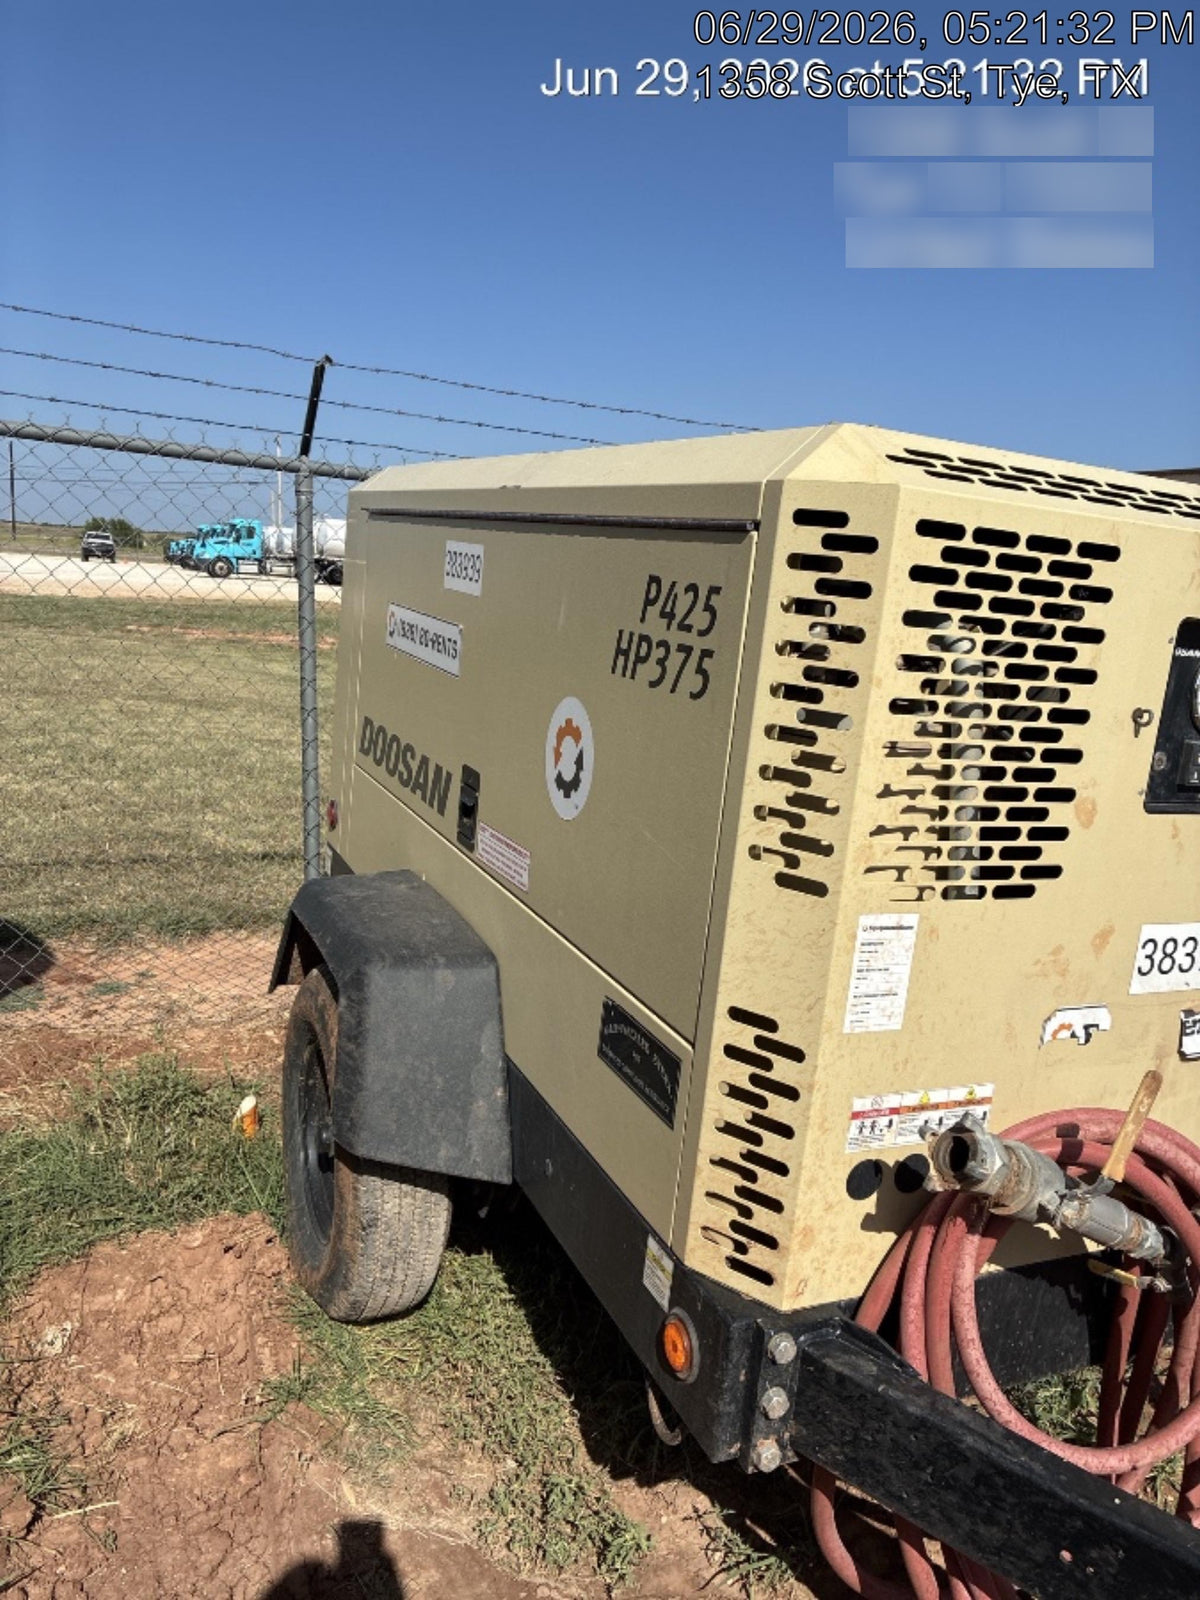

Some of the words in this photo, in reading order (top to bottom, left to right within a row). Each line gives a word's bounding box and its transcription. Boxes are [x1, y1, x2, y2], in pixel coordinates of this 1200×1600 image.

[640, 574, 722, 637] P425
[611, 629, 715, 700] HP375
[359, 716, 453, 817] DOOSAN
[1137, 936, 1200, 977] 383
